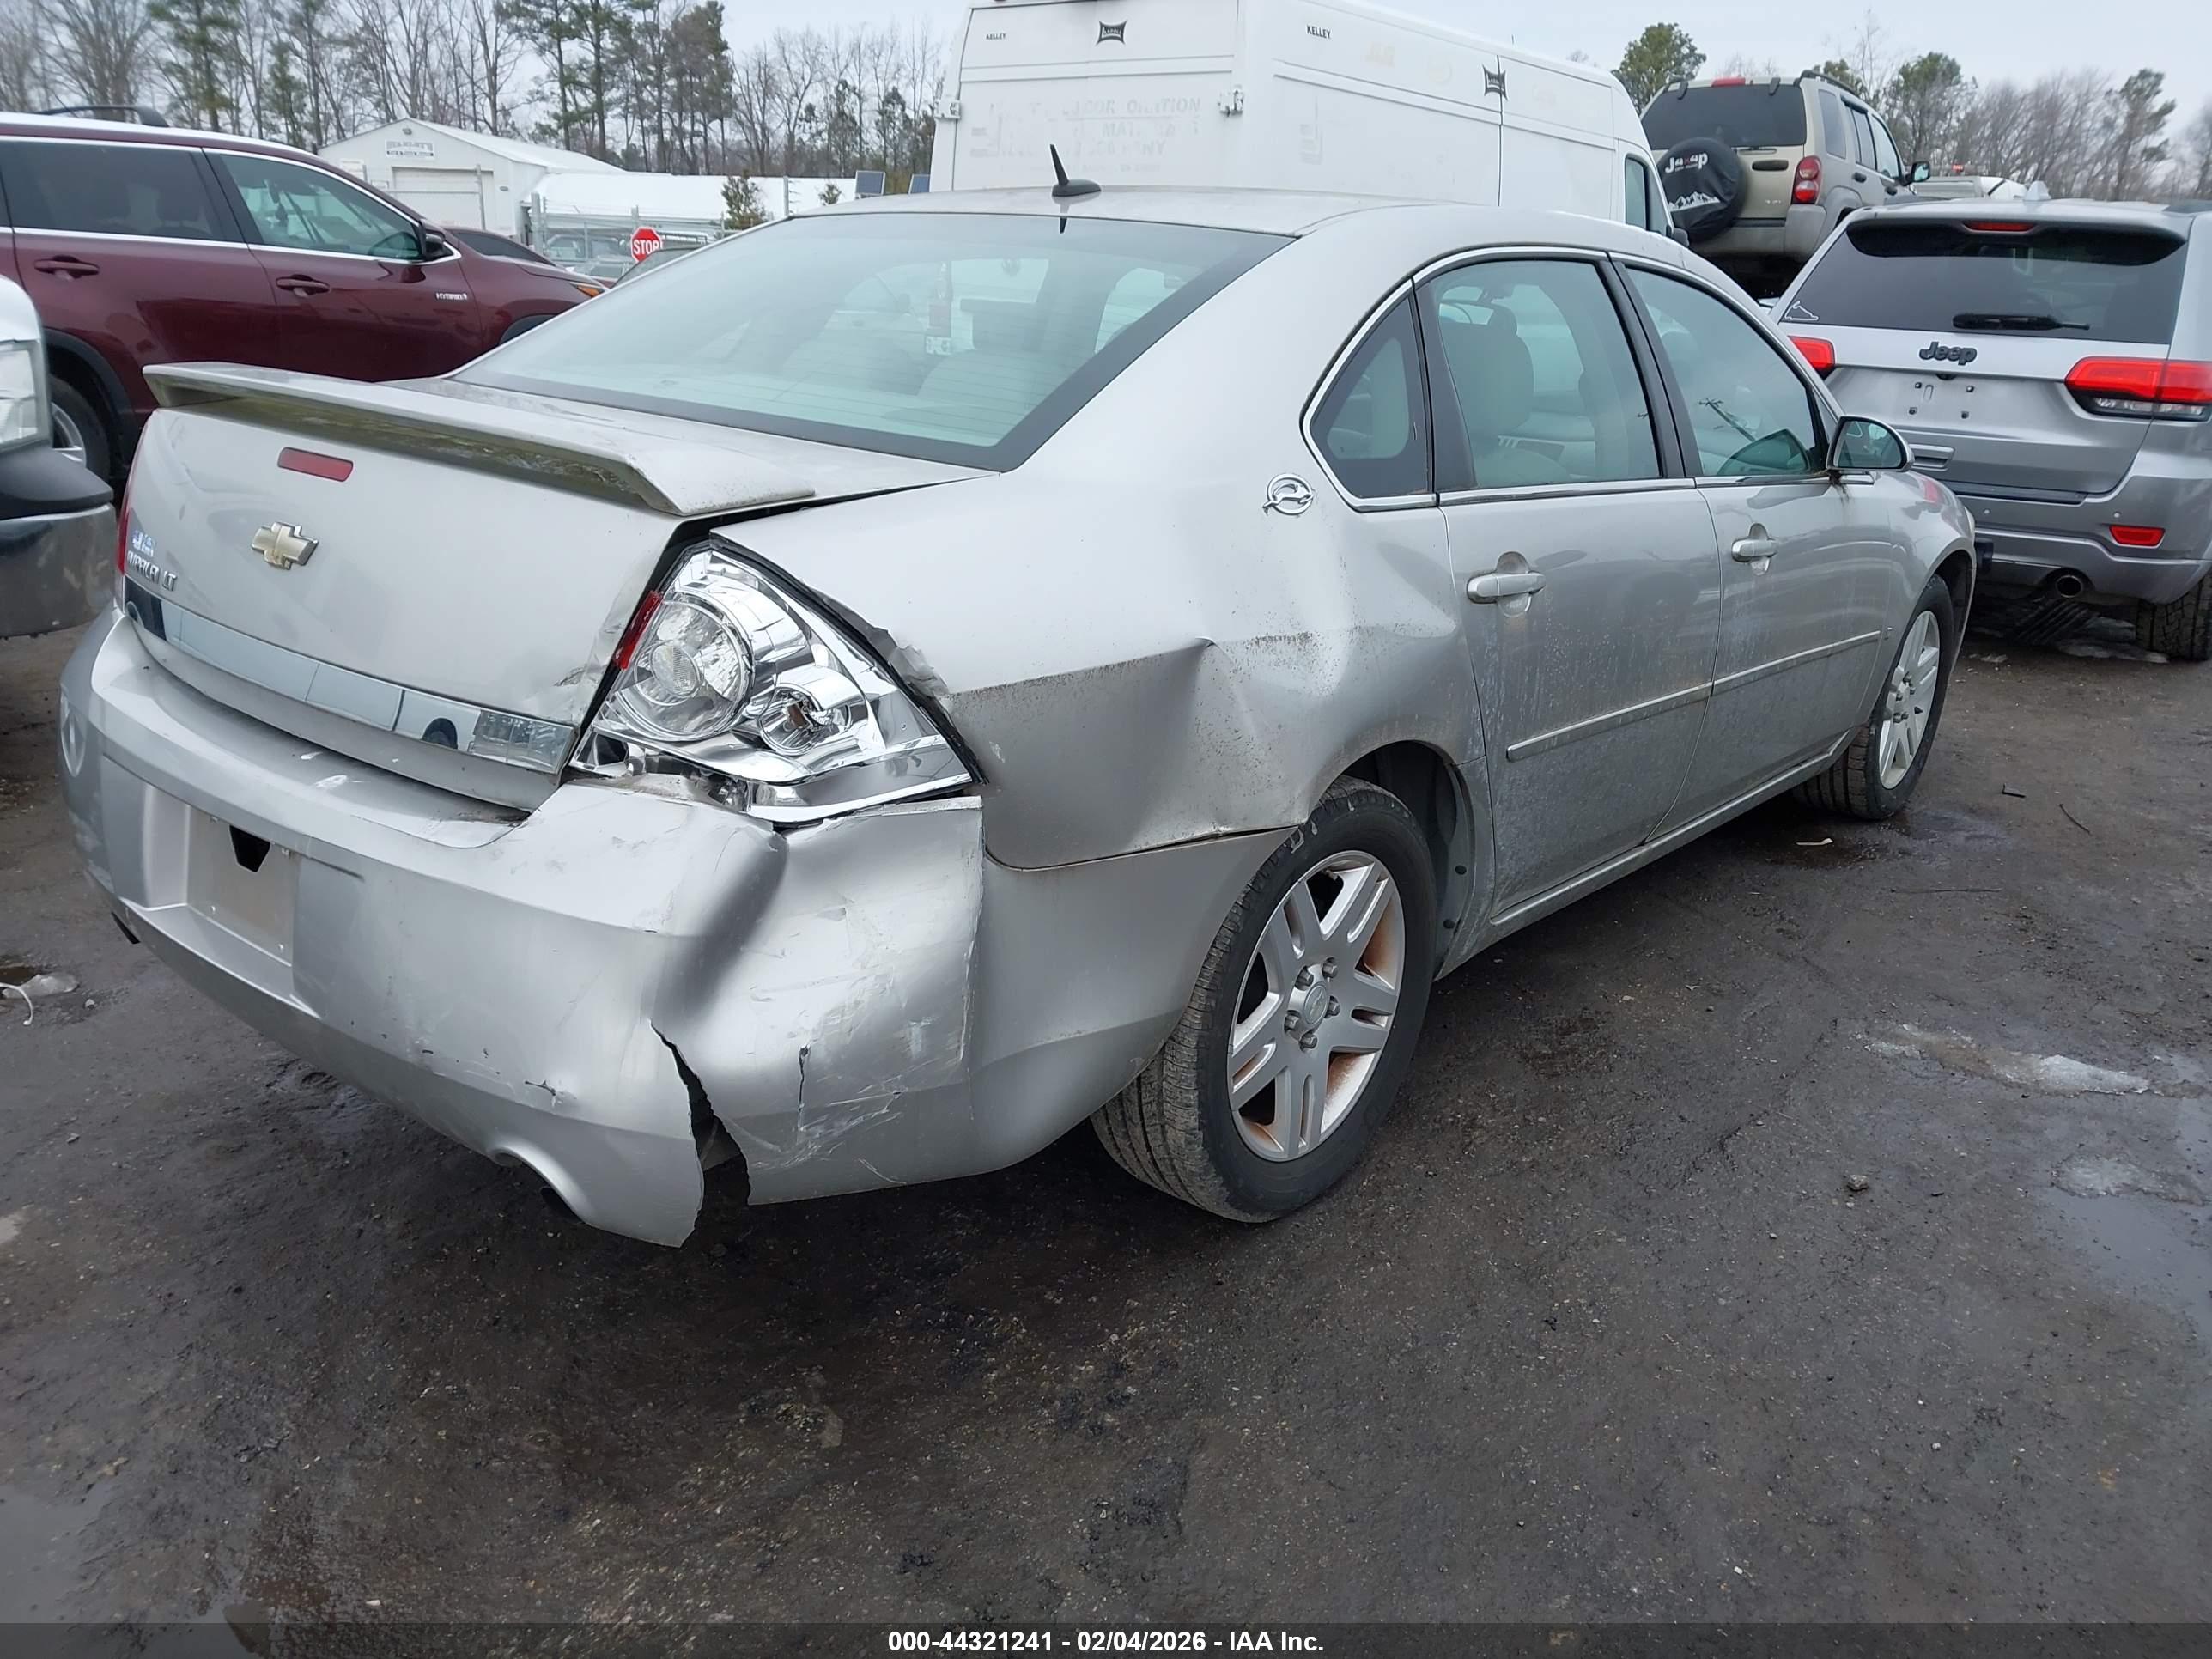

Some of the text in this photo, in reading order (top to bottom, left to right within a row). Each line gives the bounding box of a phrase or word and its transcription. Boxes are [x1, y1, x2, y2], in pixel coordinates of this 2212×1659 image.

[1306, 24, 1331, 40] KELLEY
[633, 239, 660, 255] STOP
[1919, 341, 1978, 366] Jeep
[162, 569, 178, 592] LT
